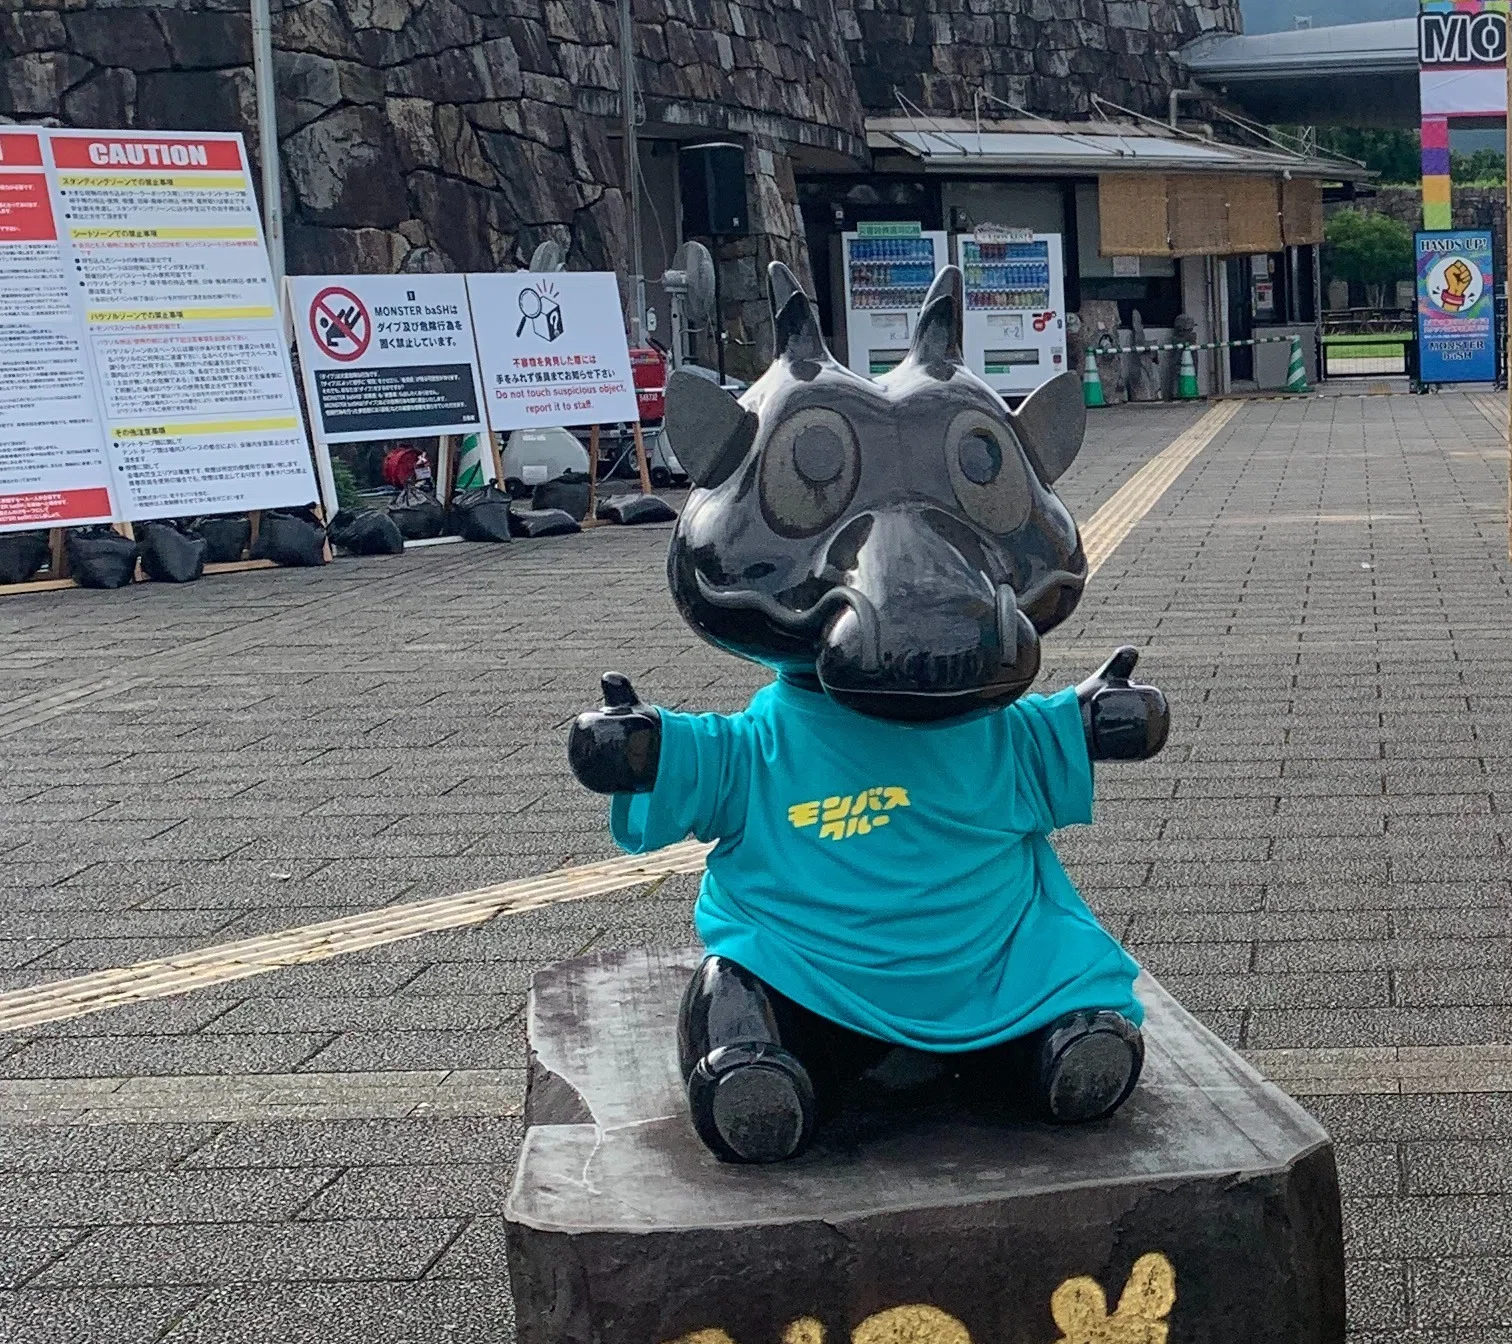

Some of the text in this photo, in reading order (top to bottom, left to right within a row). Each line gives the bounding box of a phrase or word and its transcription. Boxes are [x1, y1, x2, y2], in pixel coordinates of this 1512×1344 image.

[88, 143, 208, 166] CAUTION
[1420, 238, 1488, 252] HANDS UP!
[374, 305, 422, 317] MONSTER
[1429, 340, 1485, 351] MONSTER
[496, 390, 508, 399] Do
[510, 389, 525, 399] not
[526, 387, 551, 398] touch
[553, 385, 598, 399] suspicious
[525, 402, 553, 414] report
[563, 402, 571, 410] to
[787, 786, 912, 828] モンバス
